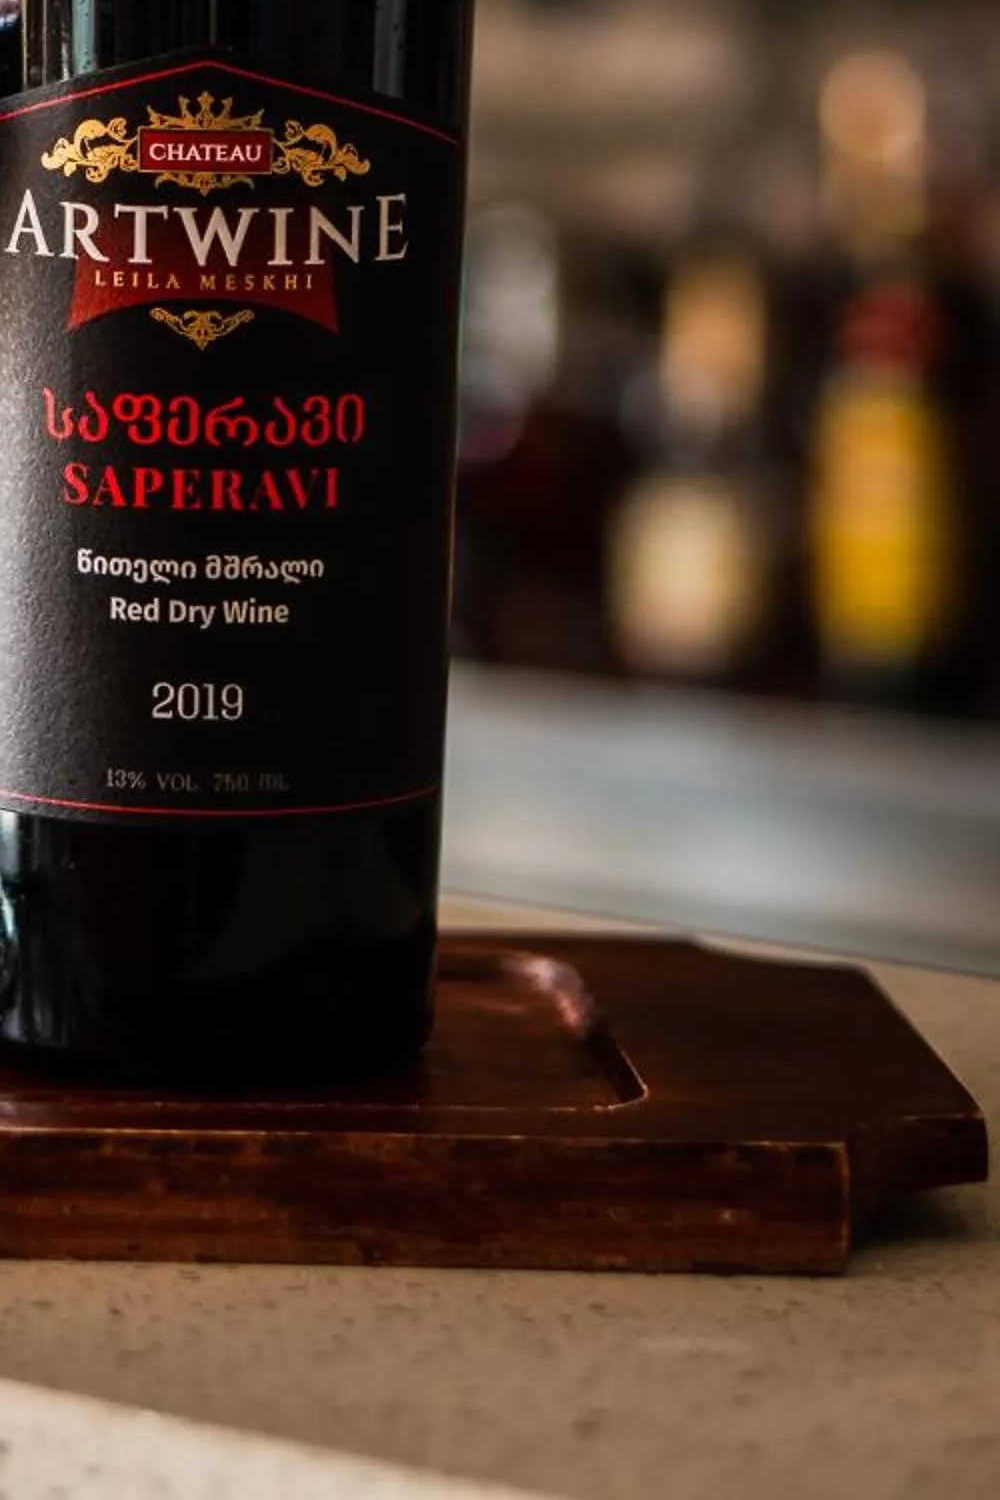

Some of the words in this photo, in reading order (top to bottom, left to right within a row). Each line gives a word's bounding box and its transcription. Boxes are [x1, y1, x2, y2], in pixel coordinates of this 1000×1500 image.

[148, 142, 262, 163] CHATEAU
[4, 188, 409, 268] ARTWINE
[94, 270, 181, 291] LEILA
[200, 274, 314, 292] MESKHI
[43, 387, 366, 447] საფერავი
[62, 461, 340, 511] SAPERAVI
[76, 547, 197, 584] წითელი
[205, 555, 325, 584] მშრალი
[110, 597, 160, 624] Red
[168, 599, 216, 629] Dry
[223, 598, 290, 624] Wine
[151, 681, 244, 721] 2019
[105, 767, 147, 790] 13%
